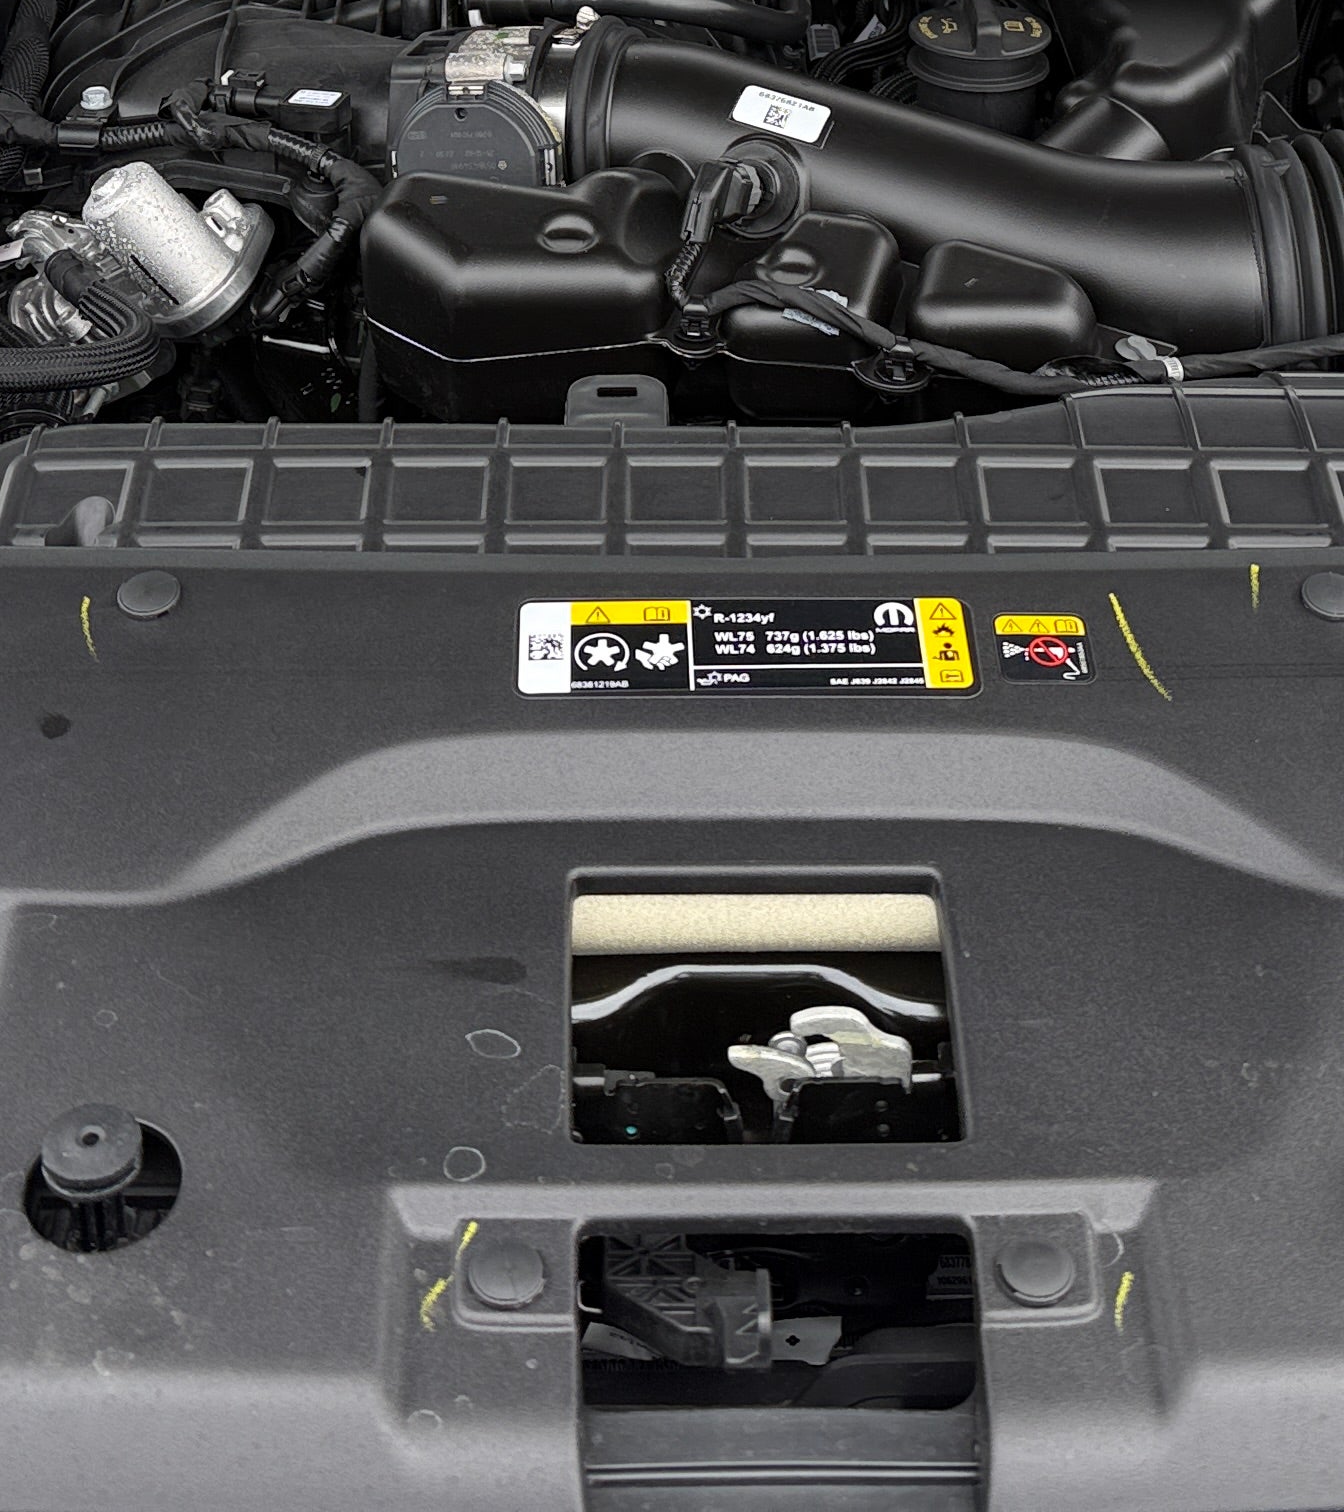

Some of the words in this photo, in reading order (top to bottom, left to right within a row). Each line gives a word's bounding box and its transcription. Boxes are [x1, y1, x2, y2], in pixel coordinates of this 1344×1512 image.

[713, 612, 775, 625] R-1234yf
[714, 631, 755, 642] WL75
[764, 631, 800, 643] 737g
[802, 630, 844, 642] (1.625
[847, 630, 875, 642] lbs)
[714, 643, 756, 654] WL74
[766, 643, 801, 656] 624g
[803, 643, 846, 655] (1.375
[849, 643, 876, 655] lbs)
[723, 673, 751, 683] PAG
[829, 677, 849, 685] SAE
